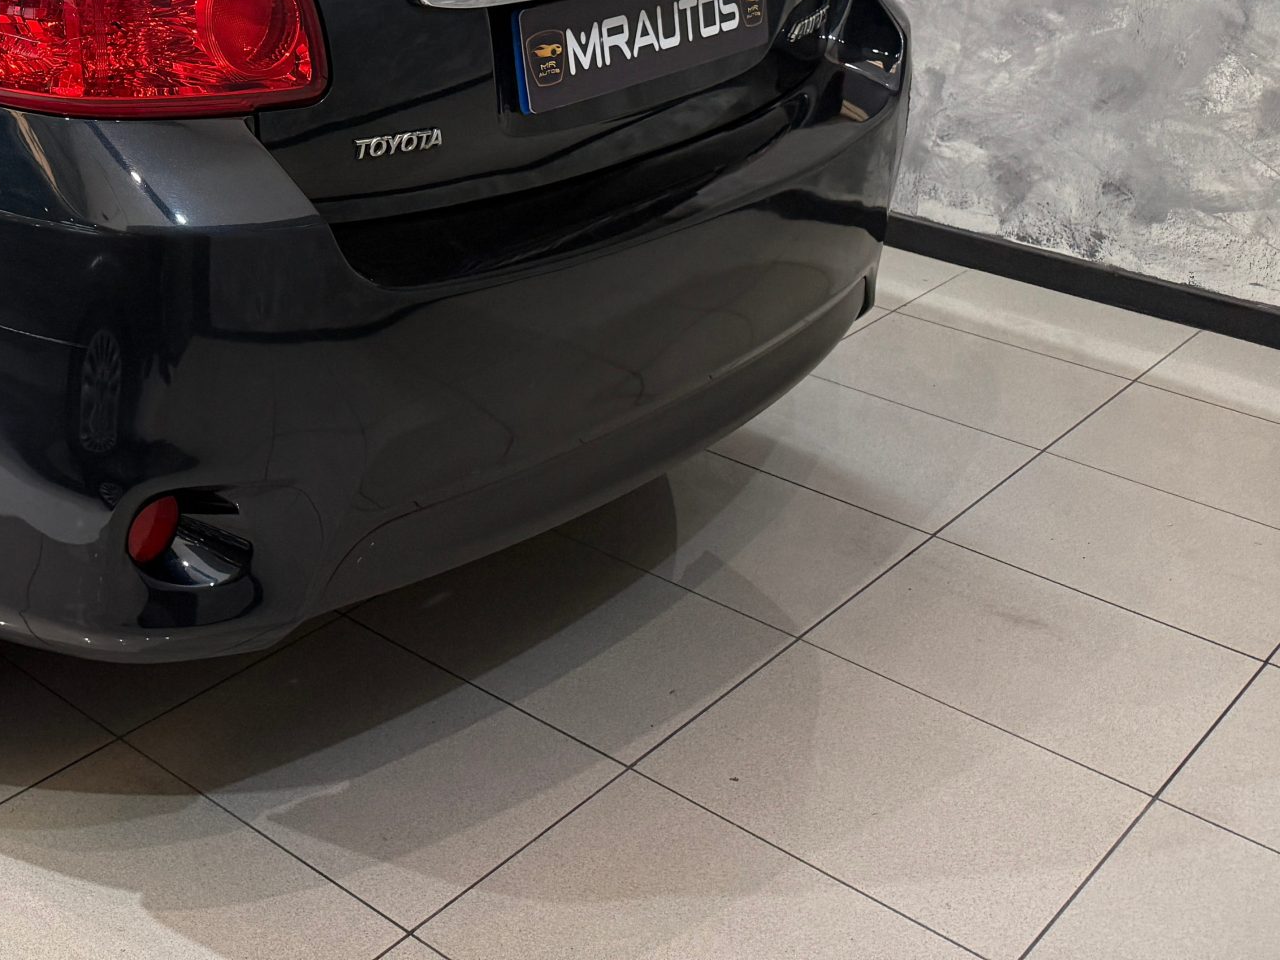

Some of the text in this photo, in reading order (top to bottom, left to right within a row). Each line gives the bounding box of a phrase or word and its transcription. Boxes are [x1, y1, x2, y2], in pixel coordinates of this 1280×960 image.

[540, 60, 557, 71] MR
[539, 68, 561, 78] AUTOS
[354, 128, 443, 160] TOYOTA
